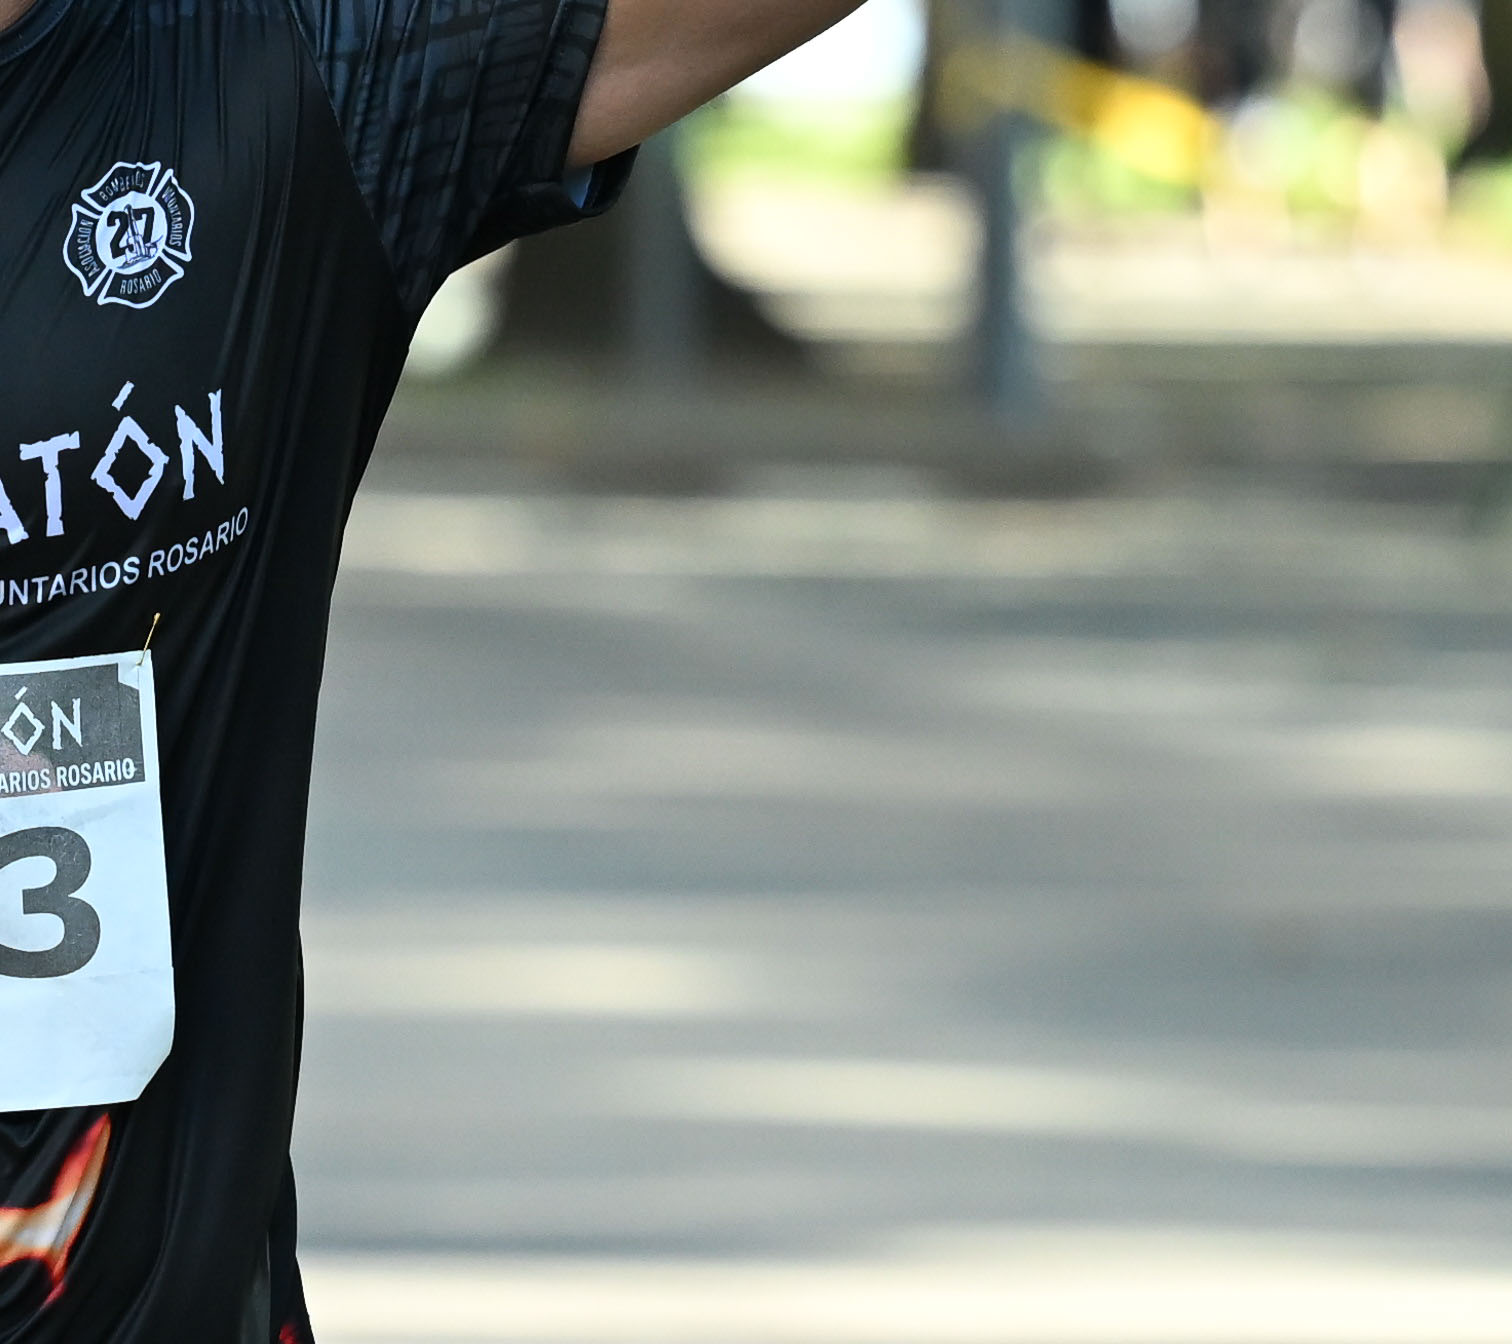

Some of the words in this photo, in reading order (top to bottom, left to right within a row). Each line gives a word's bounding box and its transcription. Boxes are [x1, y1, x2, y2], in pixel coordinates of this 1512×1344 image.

[106, 207, 155, 260] 27
[119, 268, 162, 295] ROSARIO
[147, 506, 249, 579] ROSARIO
[56, 757, 137, 788] ROSARIO
